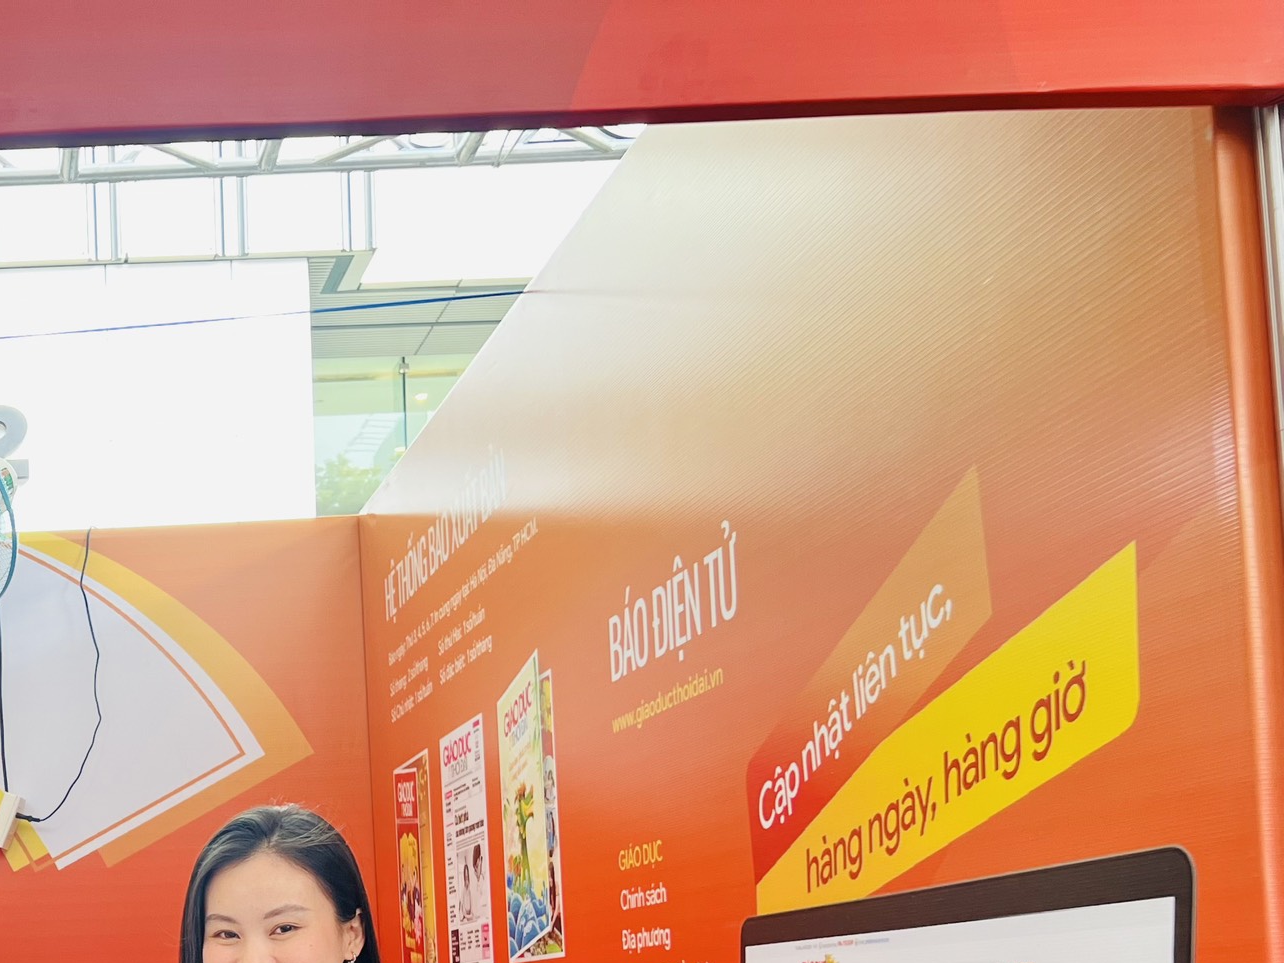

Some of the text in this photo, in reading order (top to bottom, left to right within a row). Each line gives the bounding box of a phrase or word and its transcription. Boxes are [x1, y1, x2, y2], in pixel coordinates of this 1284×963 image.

[609, 519, 737, 682] BÁO ĐIỆN TỬ
[612, 667, 724, 734] www.giaoducthoidai.vn
[757, 583, 953, 830] Cập nhật liên tục,
[806, 659, 1089, 893] hàng ngày, hàng giờ
[618, 840, 663, 871] GIÁO DỤC
[620, 882, 667, 911] Chính sách
